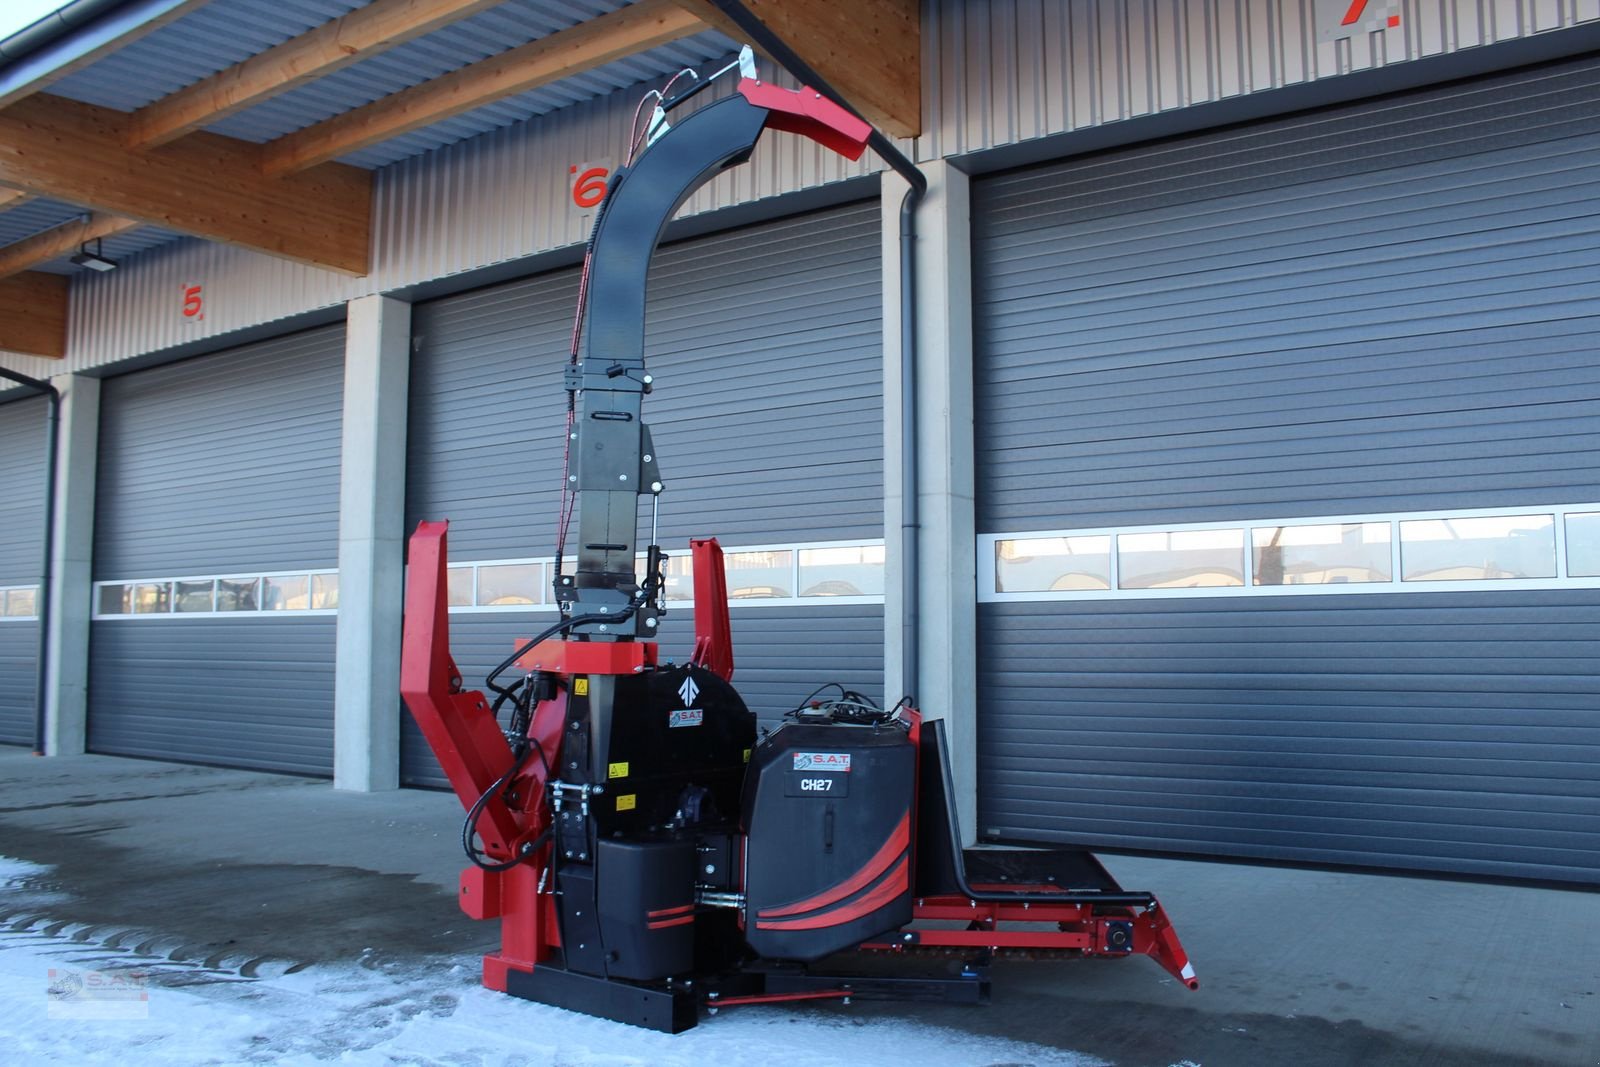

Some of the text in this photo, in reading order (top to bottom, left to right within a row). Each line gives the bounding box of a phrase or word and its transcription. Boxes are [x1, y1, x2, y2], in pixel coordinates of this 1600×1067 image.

[573, 167, 609, 208] 6
[183, 285, 202, 317] 5
[813, 755, 849, 764] S.A.T.
[801, 779, 833, 791] CH27
